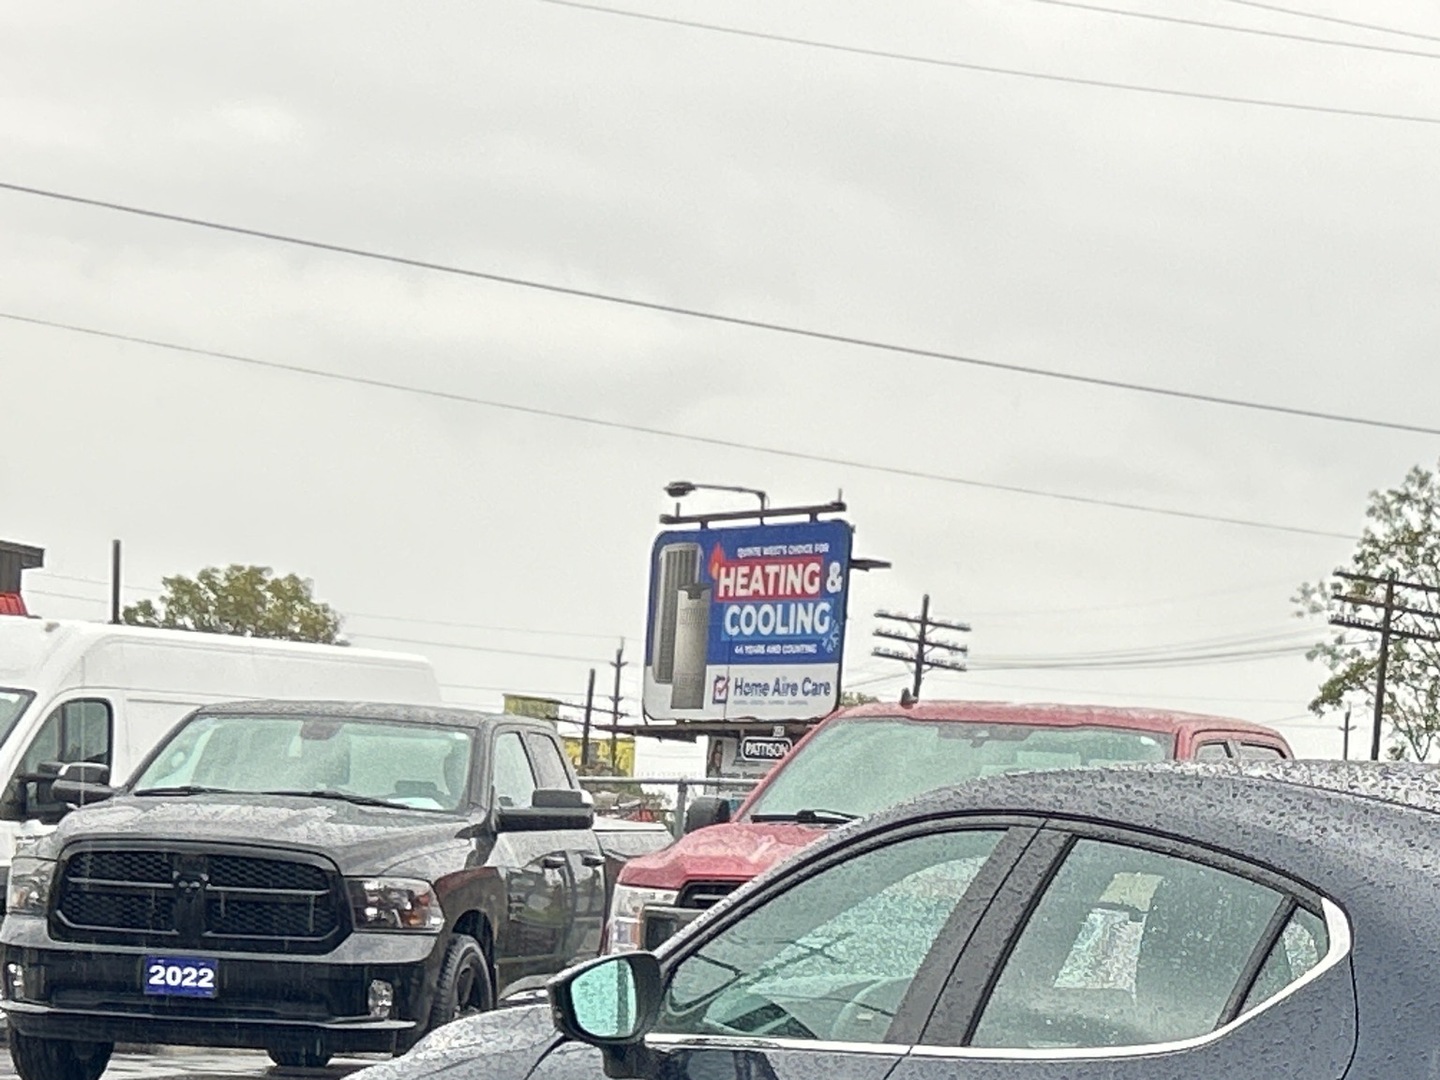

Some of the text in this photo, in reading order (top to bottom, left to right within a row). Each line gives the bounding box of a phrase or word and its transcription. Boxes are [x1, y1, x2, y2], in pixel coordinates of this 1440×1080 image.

[814, 543, 830, 553] FOR
[718, 562, 843, 597] HEATING &
[724, 602, 831, 635] COOLING
[766, 644, 781, 654] AND
[782, 643, 817, 654] COUNTING
[734, 676, 831, 697] Home Aire Care
[744, 742, 789, 757] PATTISON
[148, 964, 215, 988] 2022
